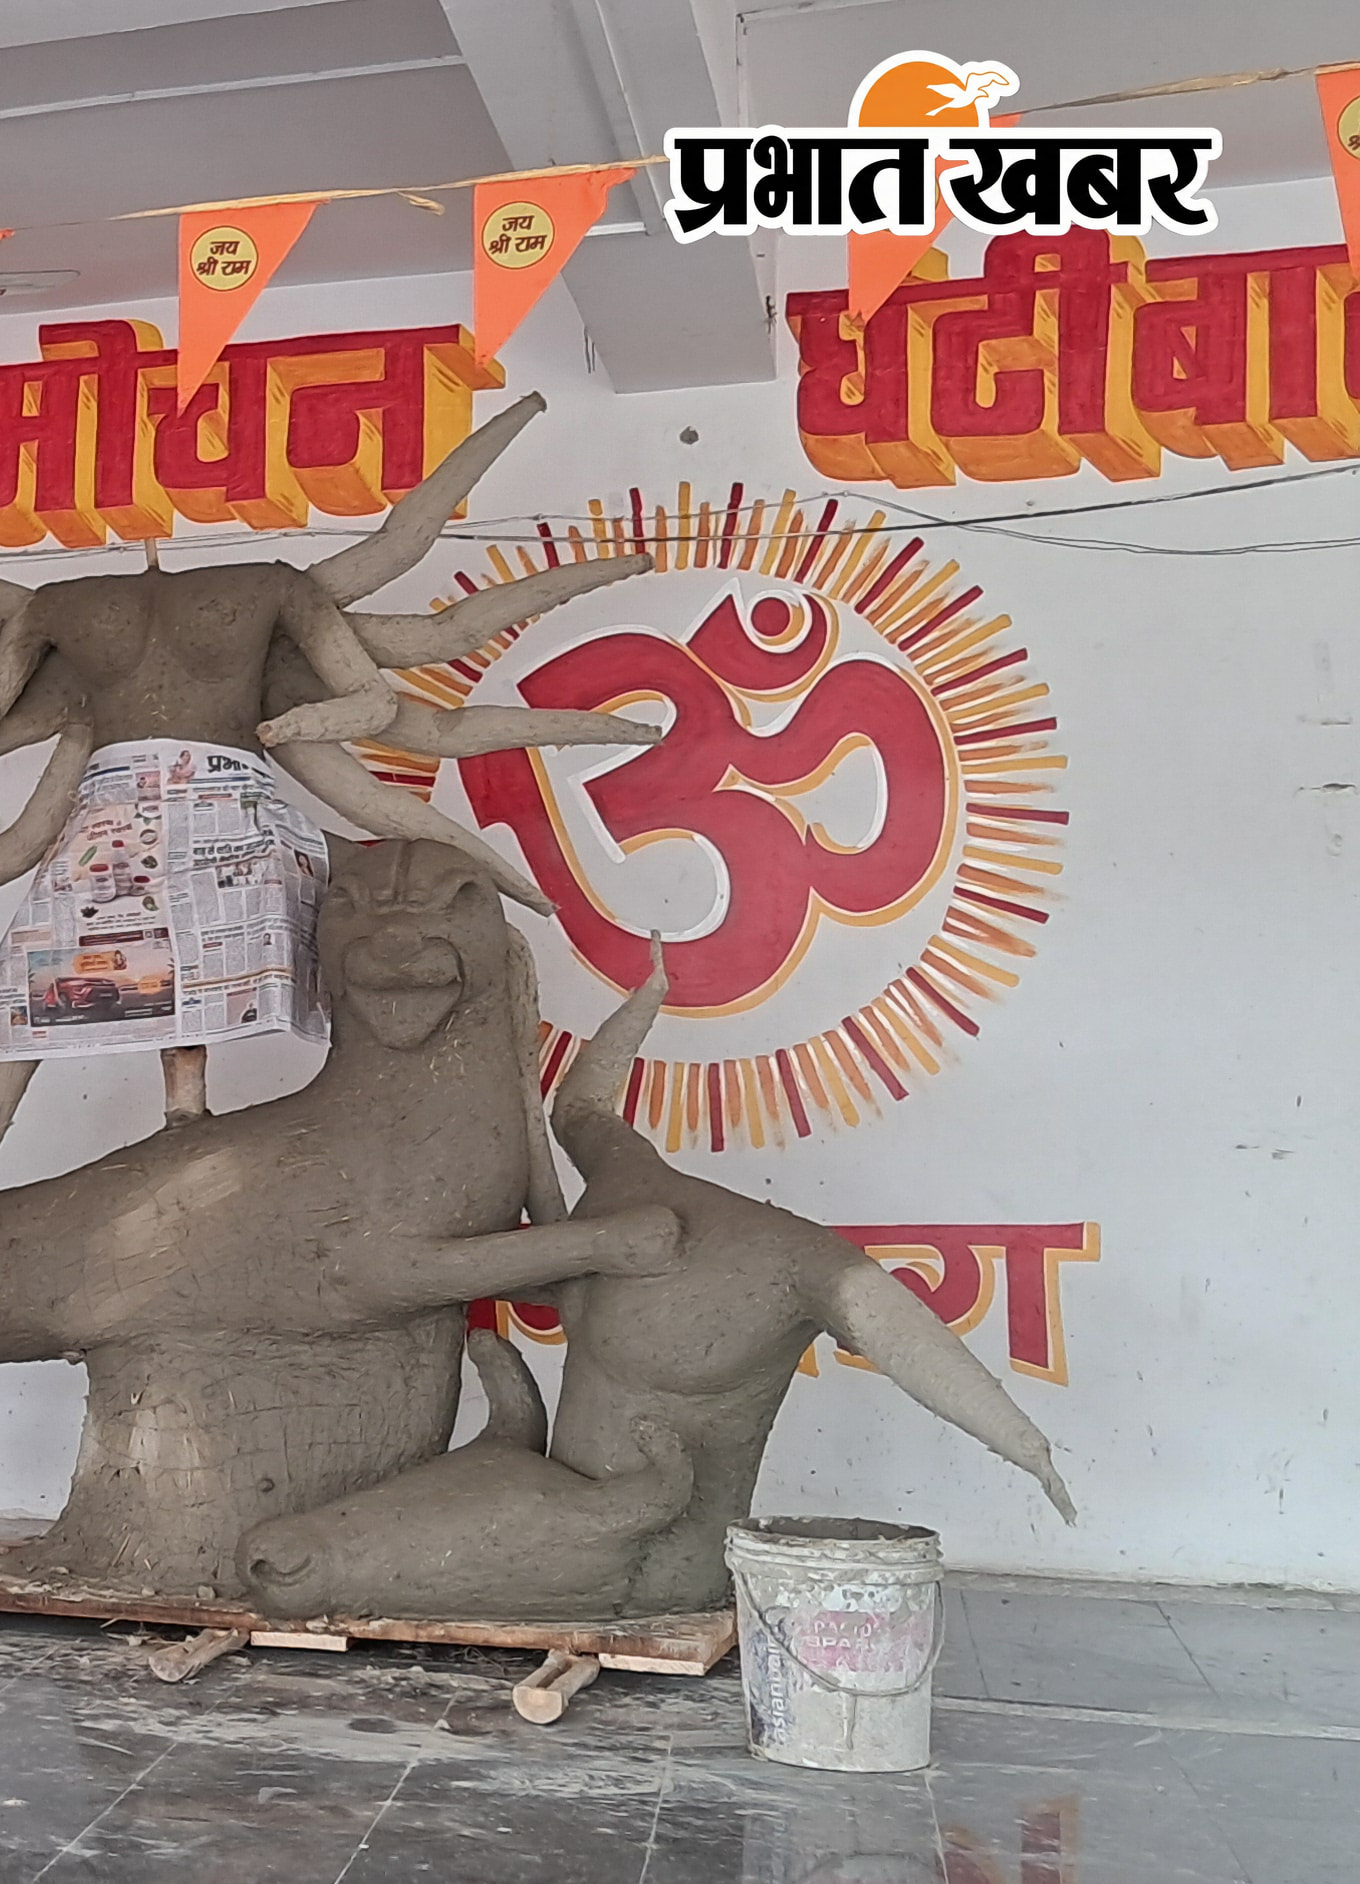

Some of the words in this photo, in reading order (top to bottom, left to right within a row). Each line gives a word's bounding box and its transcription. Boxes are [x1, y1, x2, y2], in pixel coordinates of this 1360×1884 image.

[502, 216, 534, 232] जय
[210, 241, 239, 255] जय
[489, 234, 511, 254] श्री
[515, 235, 547, 252] राम
[197, 257, 218, 275] श्री
[222, 260, 251, 274] राम
